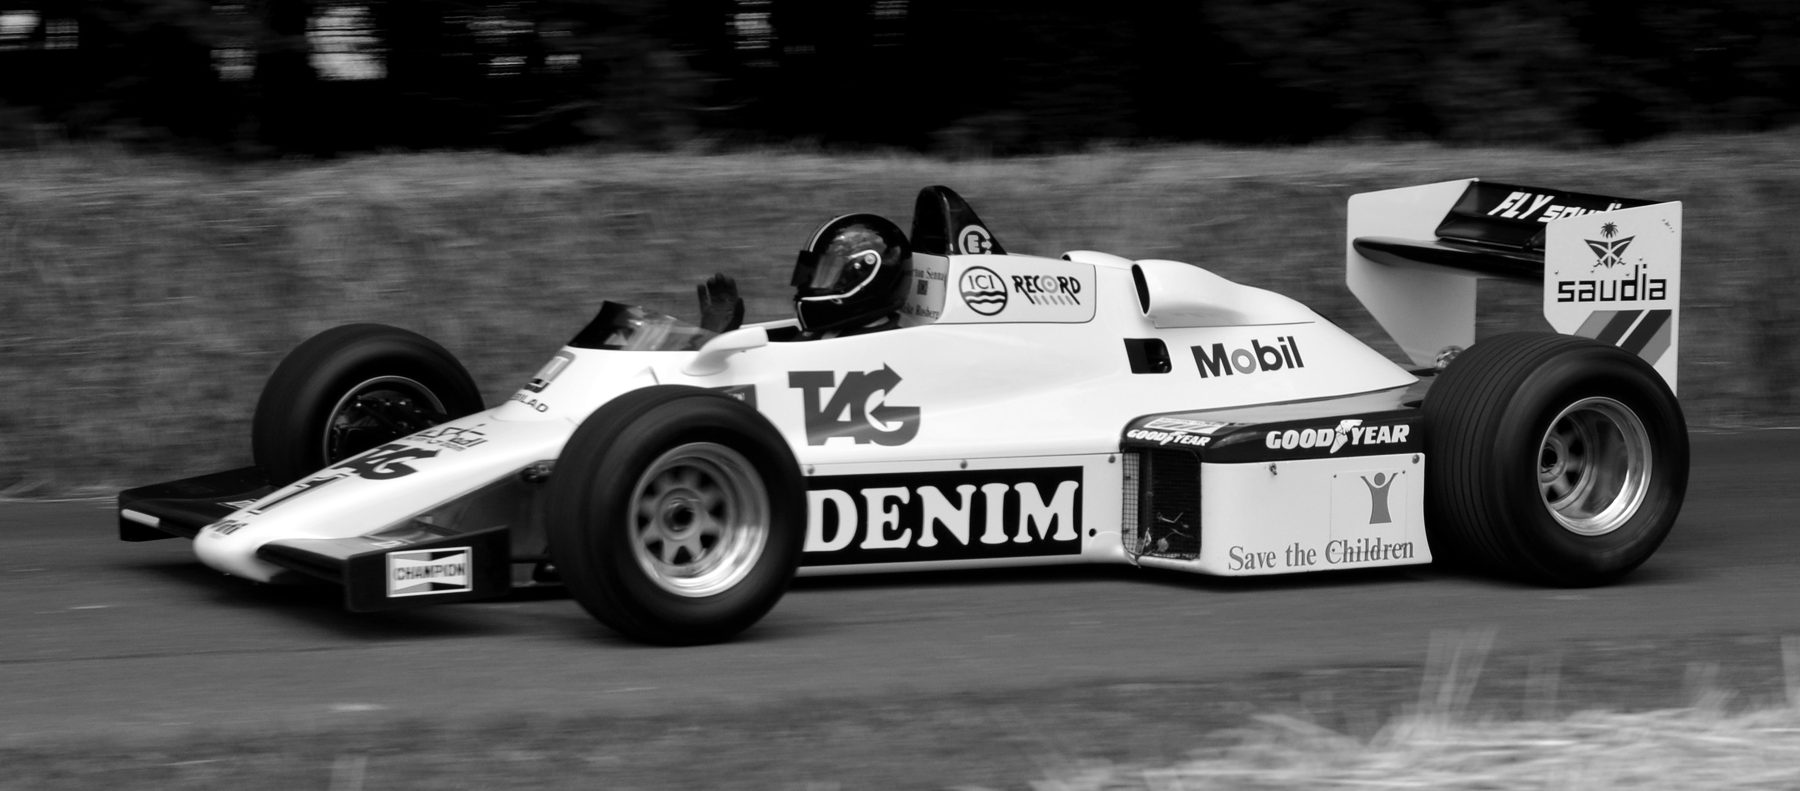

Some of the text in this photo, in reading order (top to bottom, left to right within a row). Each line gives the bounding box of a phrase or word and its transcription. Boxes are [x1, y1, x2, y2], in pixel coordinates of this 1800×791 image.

[1487, 191, 1555, 219] FLY
[968, 274, 996, 290] ICI
[1011, 274, 1081, 305] RECORD
[1557, 263, 1667, 302] saudia
[1190, 336, 1304, 378] Mobil
[788, 362, 921, 446] TAG
[802, 480, 1079, 552] DENIM
[1228, 537, 1415, 571] Save the Children
[394, 563, 466, 580] CHAMPION
